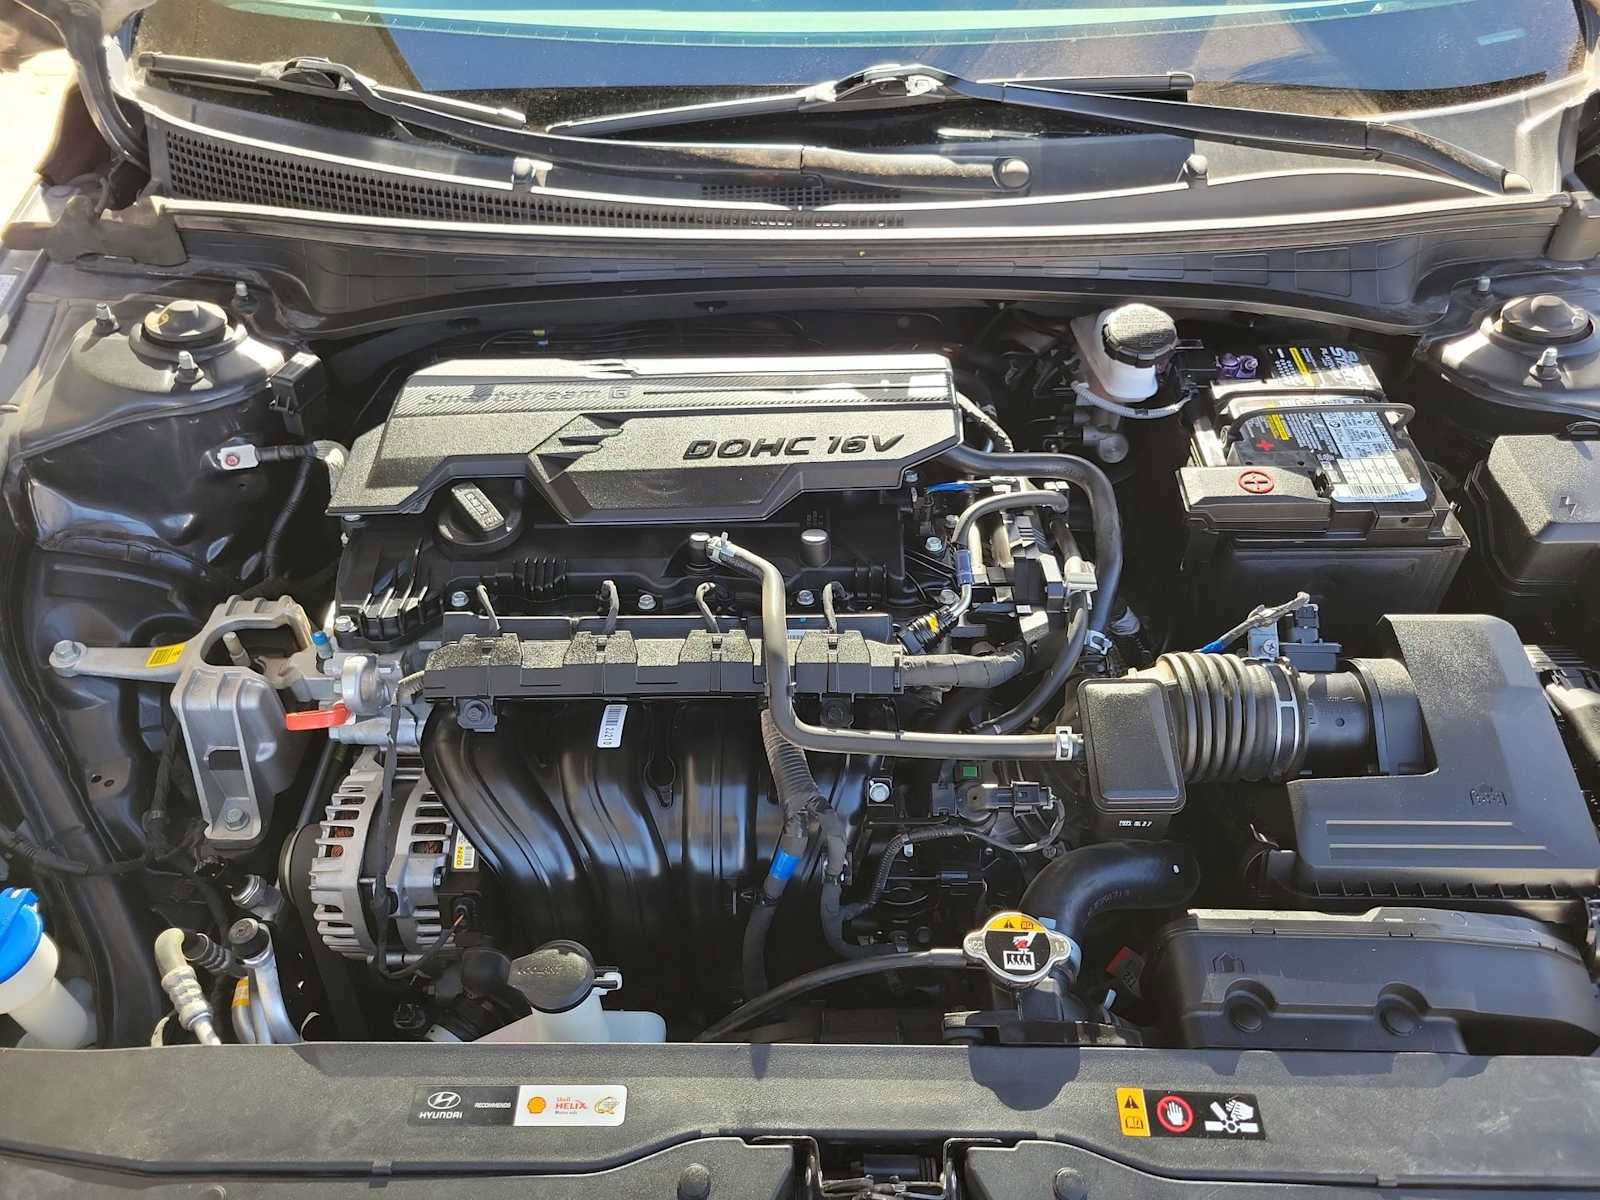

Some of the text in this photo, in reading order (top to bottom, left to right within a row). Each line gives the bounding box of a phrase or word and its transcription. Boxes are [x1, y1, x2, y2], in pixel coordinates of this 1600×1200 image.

[683, 434, 905, 460] DOHC 16V
[555, 1102, 588, 1110] HELIX
[419, 1111, 463, 1119] HYUNDAI
